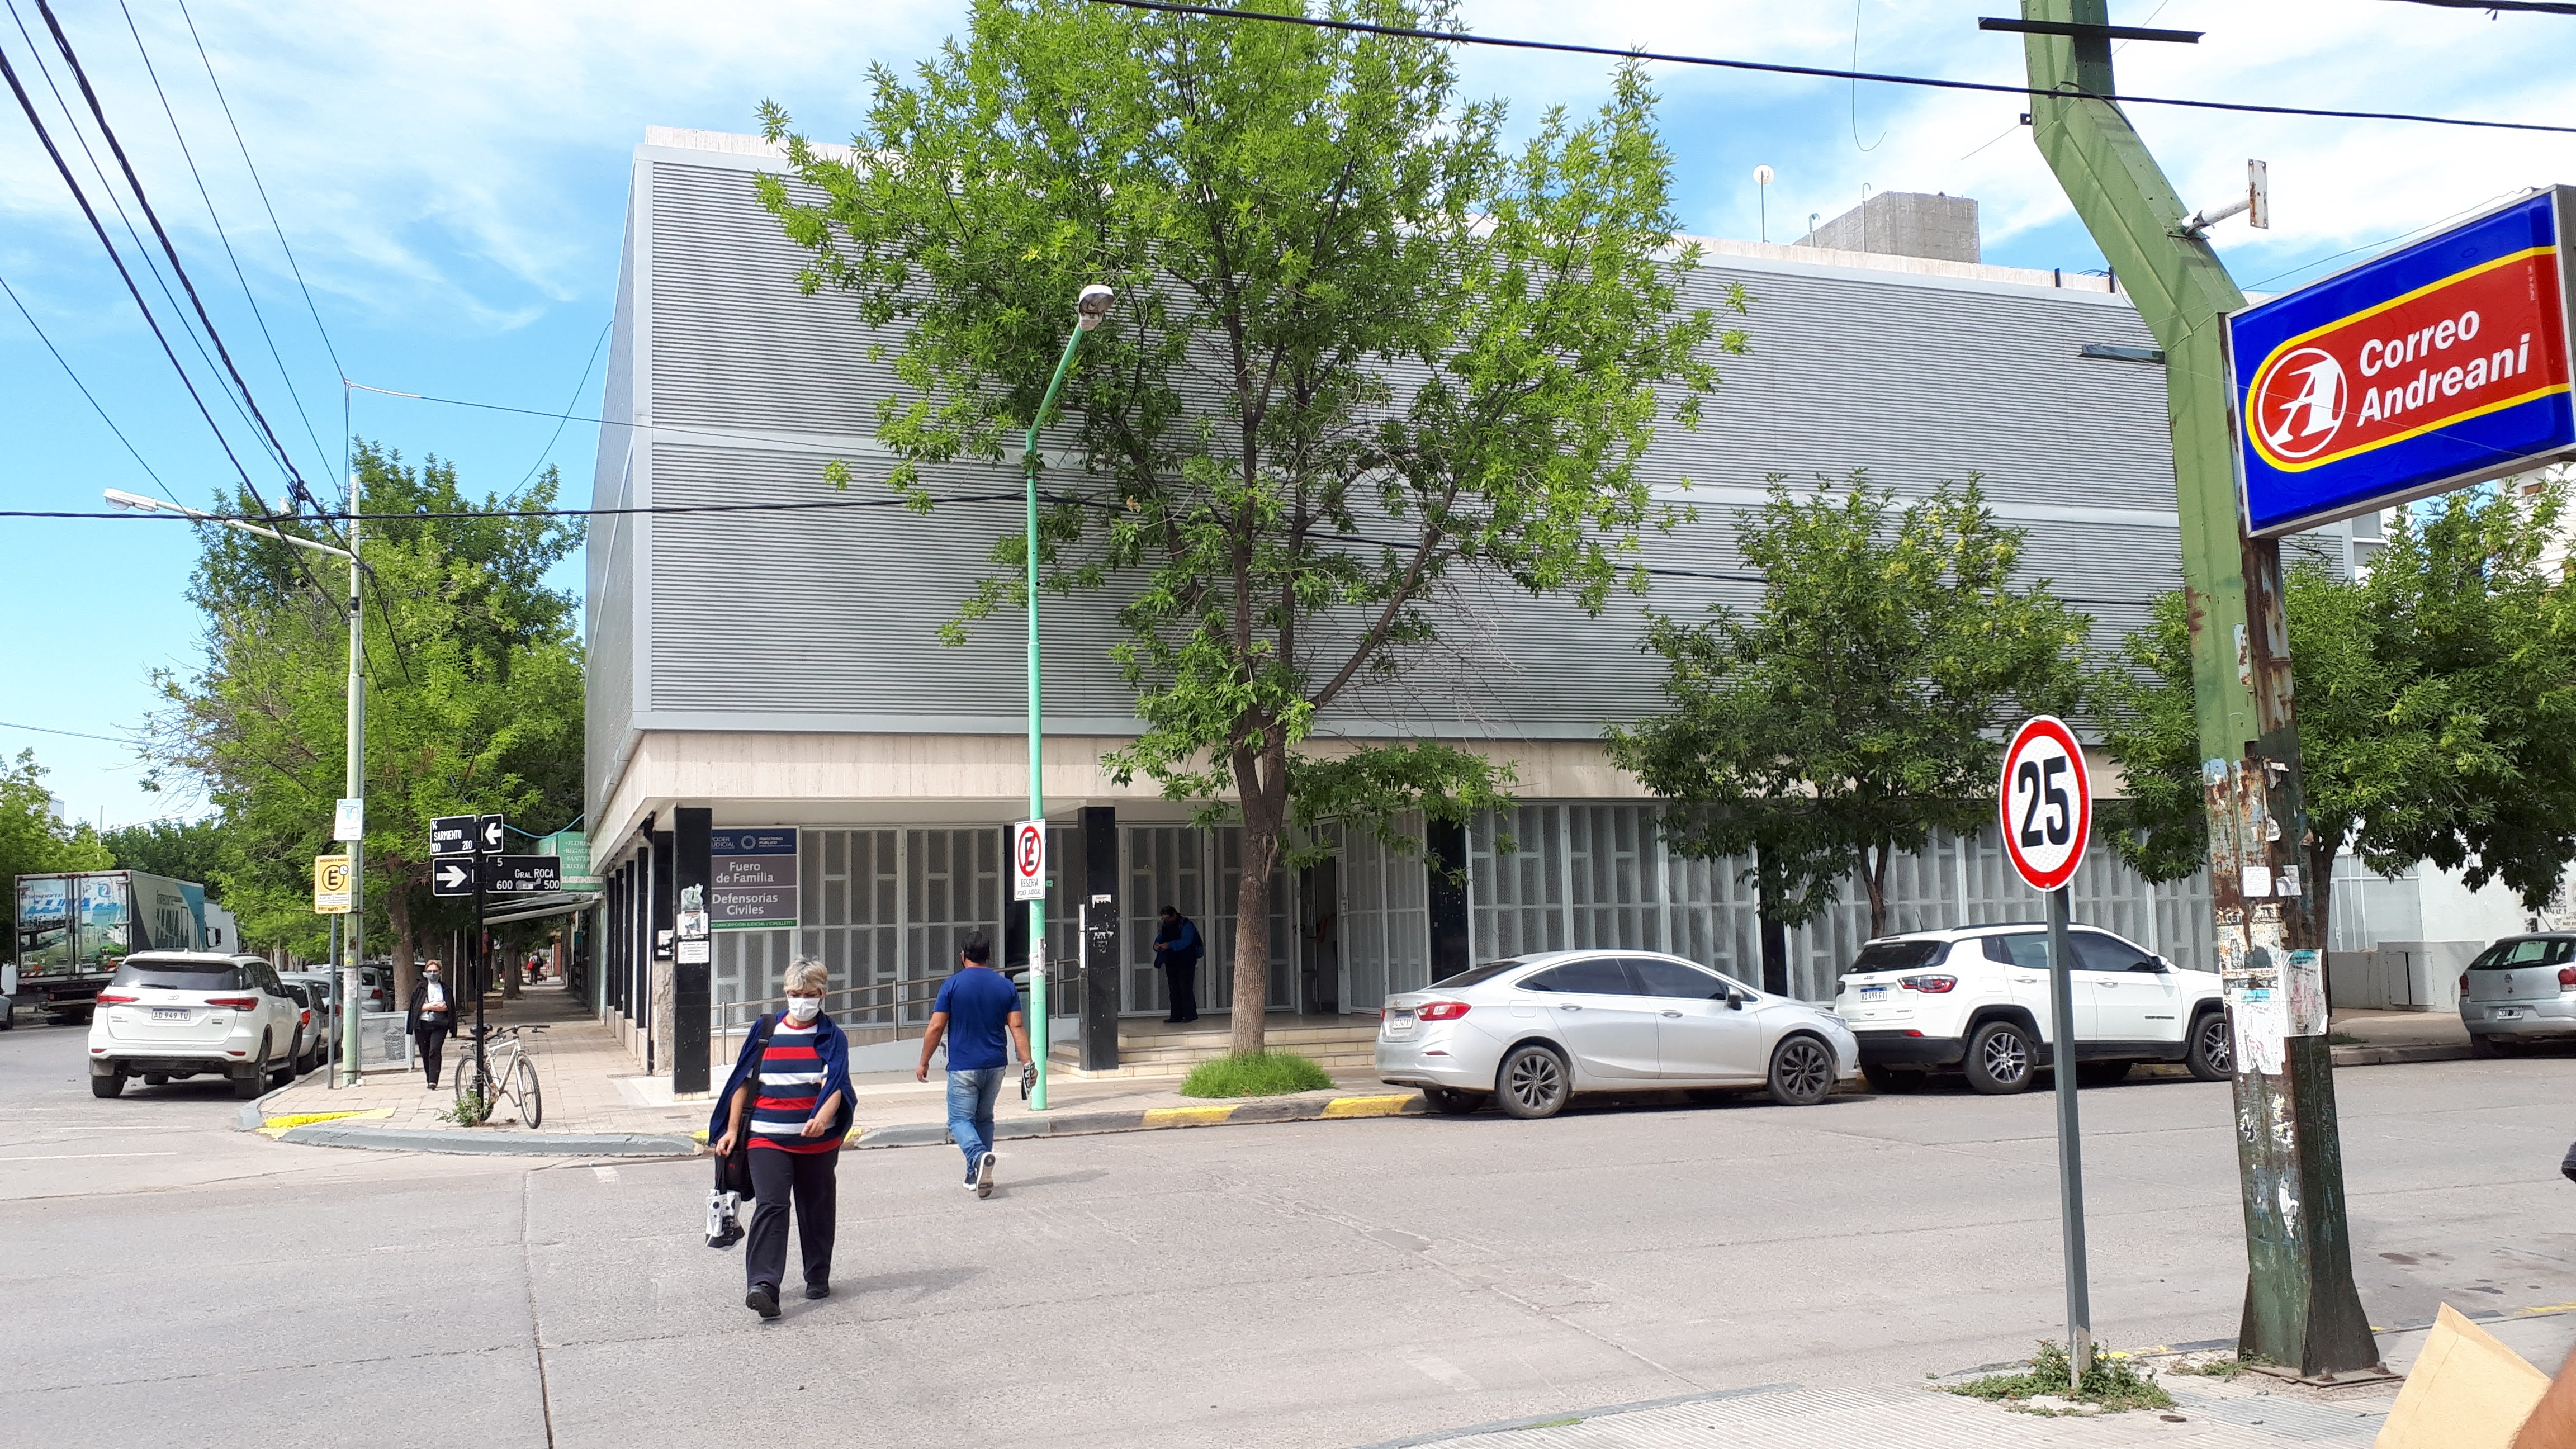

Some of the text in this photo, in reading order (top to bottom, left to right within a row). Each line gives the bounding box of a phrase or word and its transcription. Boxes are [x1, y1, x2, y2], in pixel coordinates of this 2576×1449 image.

[2360, 310, 2480, 377] Correo
[2357, 333, 2531, 428] Andreani
[2018, 755, 2071, 848] 25
[432, 821, 438, 830] 14
[434, 830, 462, 841] SARMIENTO
[432, 840, 472, 853] 100 200
[497, 858, 503, 867] 5
[730, 861, 761, 872] Fuero
[534, 868, 554, 878] ROCA
[716, 872, 774, 883] de Familia
[496, 880, 560, 890] 600 500
[1021, 878, 1038, 888] RESERVA
[712, 893, 779, 904] Defensorías
[727, 904, 764, 915] Civiles
